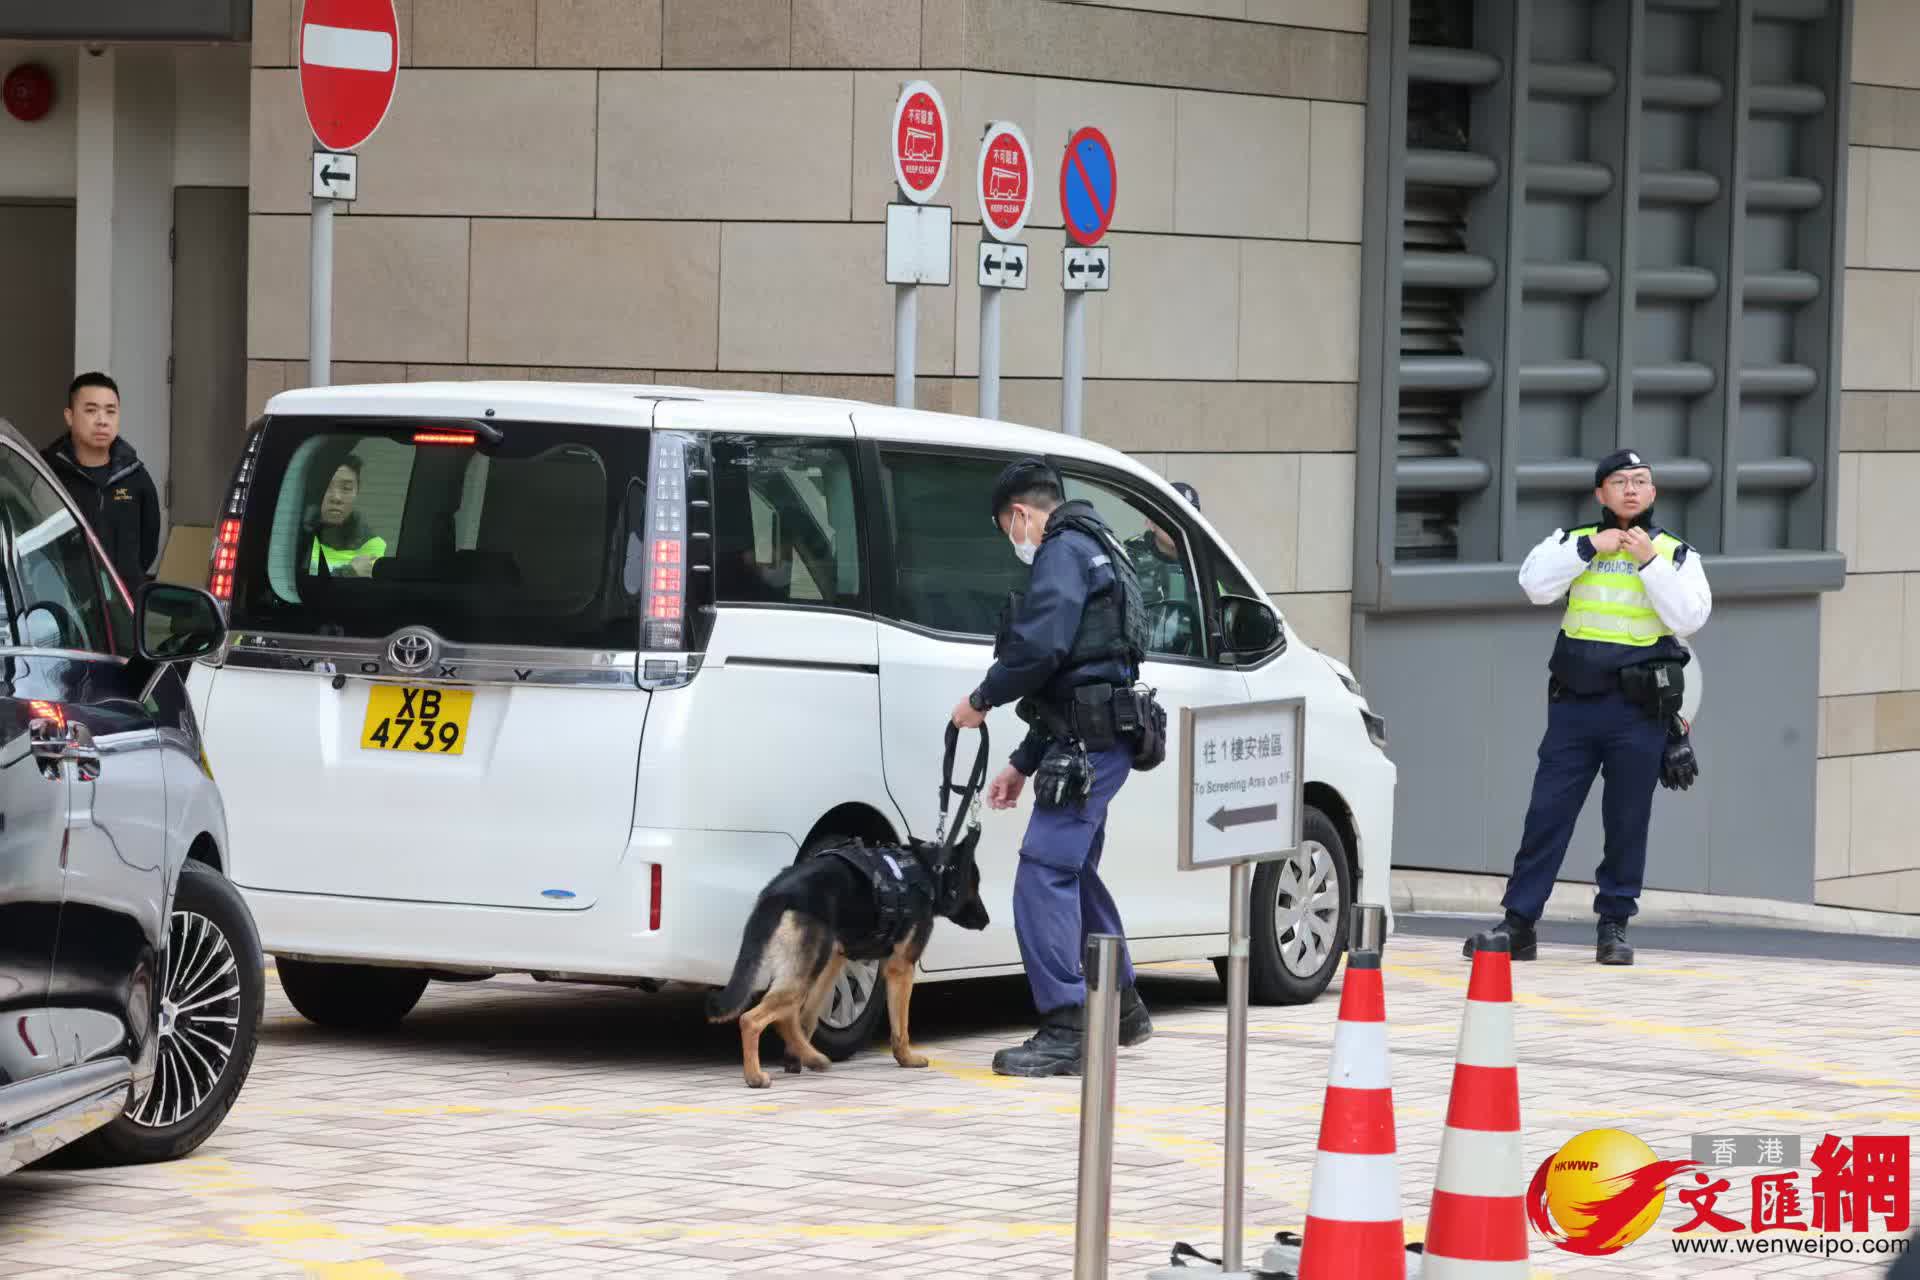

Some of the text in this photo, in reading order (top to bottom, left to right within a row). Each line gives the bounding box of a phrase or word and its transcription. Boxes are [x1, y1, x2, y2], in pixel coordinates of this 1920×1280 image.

[906, 165, 935, 174] KEEP CLEAR
[990, 204, 1020, 213] KEEP CLEAR
[1597, 560, 1634, 575] POLICE
[397, 687, 442, 719] XB
[369, 717, 460, 752] 4739
[1194, 782, 1205, 794] To
[1207, 779, 1247, 794] Screening
[1249, 776, 1267, 788] Area
[1268, 775, 1278, 787] on
